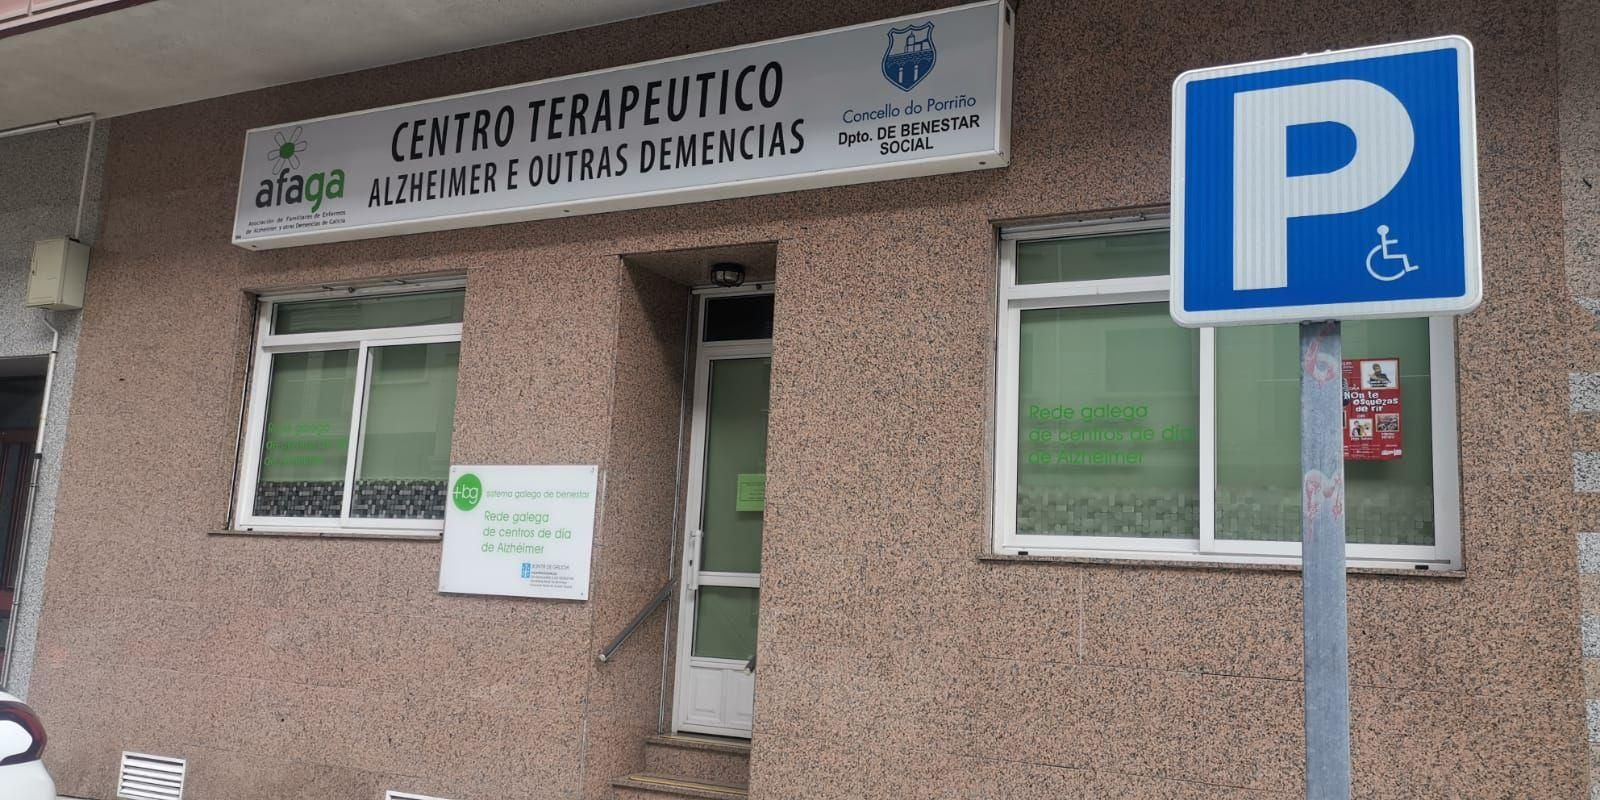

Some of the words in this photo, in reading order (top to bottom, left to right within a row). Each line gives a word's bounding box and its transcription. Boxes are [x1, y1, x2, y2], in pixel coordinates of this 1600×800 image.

[391, 105, 514, 162] CENTRO
[529, 61, 783, 142] TERAPEUTICO
[842, 103, 900, 123] Concello
[904, 100, 922, 115] do
[927, 95, 976, 112] Porriño
[838, 131, 873, 147] Dpto.
[877, 125, 896, 140] DE
[901, 114, 980, 137] BENESTAR
[880, 137, 934, 155] SOCIAL
[368, 162, 497, 208] ALZHEIMER
[507, 158, 519, 191] E
[529, 143, 628, 187] OUTRAS
[639, 118, 805, 174] DEMENCIAS
[255, 168, 345, 213] afaga
[1233, 79, 1414, 290] P
[1029, 405, 1074, 419] Rede
[1080, 404, 1149, 422] galega
[1028, 427, 1051, 442] de
[1058, 428, 1124, 441] centros
[1130, 426, 1154, 441] de
[1028, 449, 1051, 464] de
[514, 490, 541, 499] galego
[543, 490, 554, 498] de
[556, 490, 590, 498] benestar
[484, 510, 509, 522] Rede
[512, 512, 549, 524] galega
[482, 527, 496, 537] de
[498, 527, 535, 538] centros
[538, 528, 551, 538] de
[481, 542, 494, 553] de
